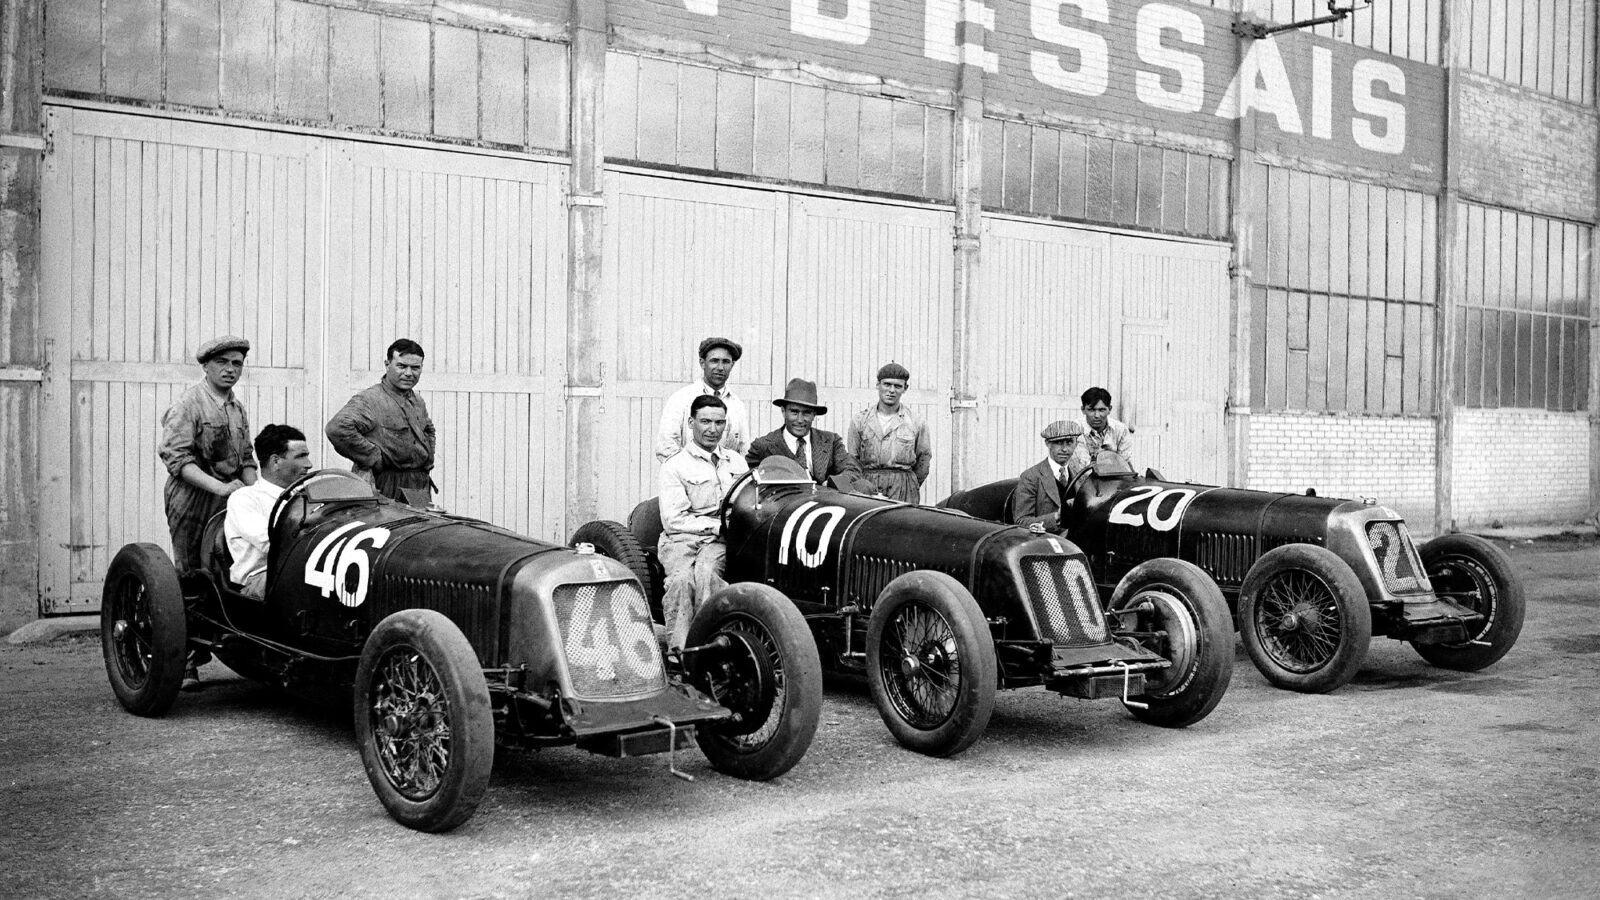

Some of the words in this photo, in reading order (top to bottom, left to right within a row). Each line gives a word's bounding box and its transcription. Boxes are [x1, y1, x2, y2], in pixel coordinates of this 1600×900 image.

[778, 501, 846, 569] 10
[1109, 485, 1196, 532] 20
[304, 521, 391, 608] 46
[1031, 559, 1107, 642] 10
[565, 583, 661, 680] 46
